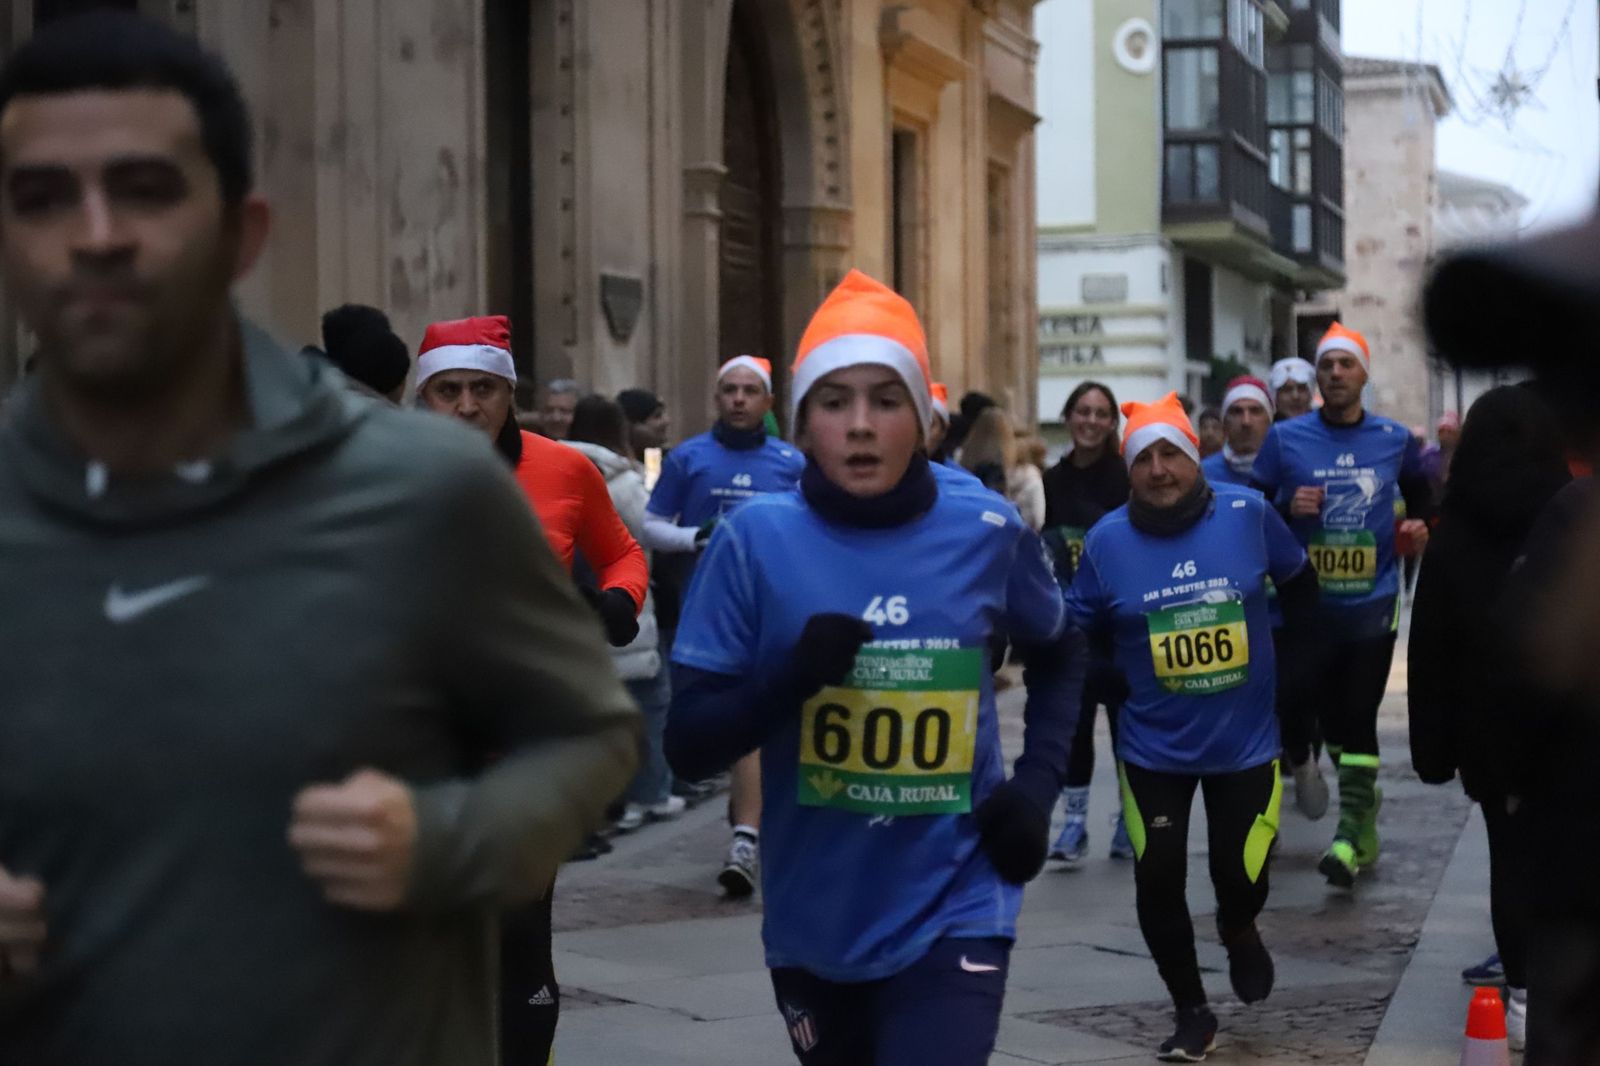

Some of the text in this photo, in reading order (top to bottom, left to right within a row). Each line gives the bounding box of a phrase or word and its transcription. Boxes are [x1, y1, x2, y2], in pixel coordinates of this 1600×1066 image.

[1336, 453, 1355, 467] 46
[1172, 560, 1197, 579] 46
[1313, 549, 1365, 574] 1040
[1143, 590, 1160, 602] SAN
[1162, 580, 1206, 597] SILVESTRE
[862, 595, 909, 626] 46
[1158, 628, 1233, 669] 1066
[889, 668, 933, 681] RURAL
[1184, 671, 1244, 689] CAJA RURAL
[813, 703, 951, 770] 600
[847, 784, 961, 803] CAJA RURAL
